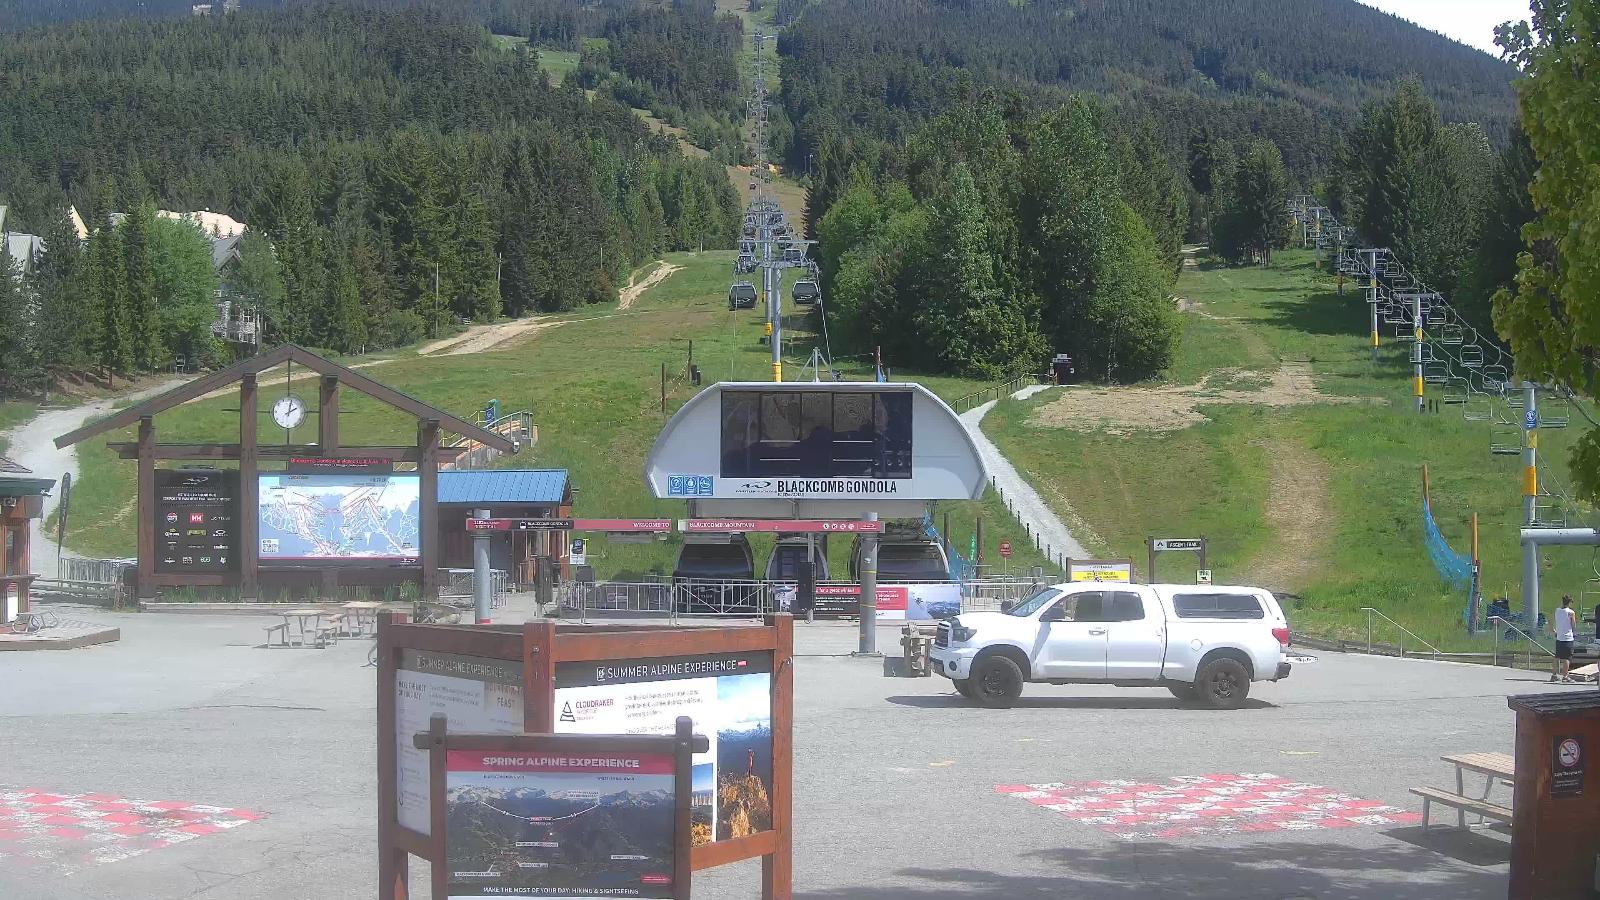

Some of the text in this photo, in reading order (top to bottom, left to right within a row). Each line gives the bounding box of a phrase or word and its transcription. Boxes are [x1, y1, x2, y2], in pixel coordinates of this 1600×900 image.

[777, 480, 897, 493] BLACKCOMB GONDOLA
[632, 521, 670, 529] WELCOME TO
[446, 660, 465, 673] ALPINE
[466, 663, 503, 678] EXPERIENCE
[607, 659, 737, 679] SUMMER ALPINE EXPERIENCE
[496, 697, 515, 709] FEAST
[575, 698, 614, 709] CLOUDRAKER
[482, 757, 640, 768] SPRING ALPINE EXPERIENCE
[483, 886, 500, 894] MAKE
[501, 886, 512, 894] THE
[513, 886, 531, 894] MOST
